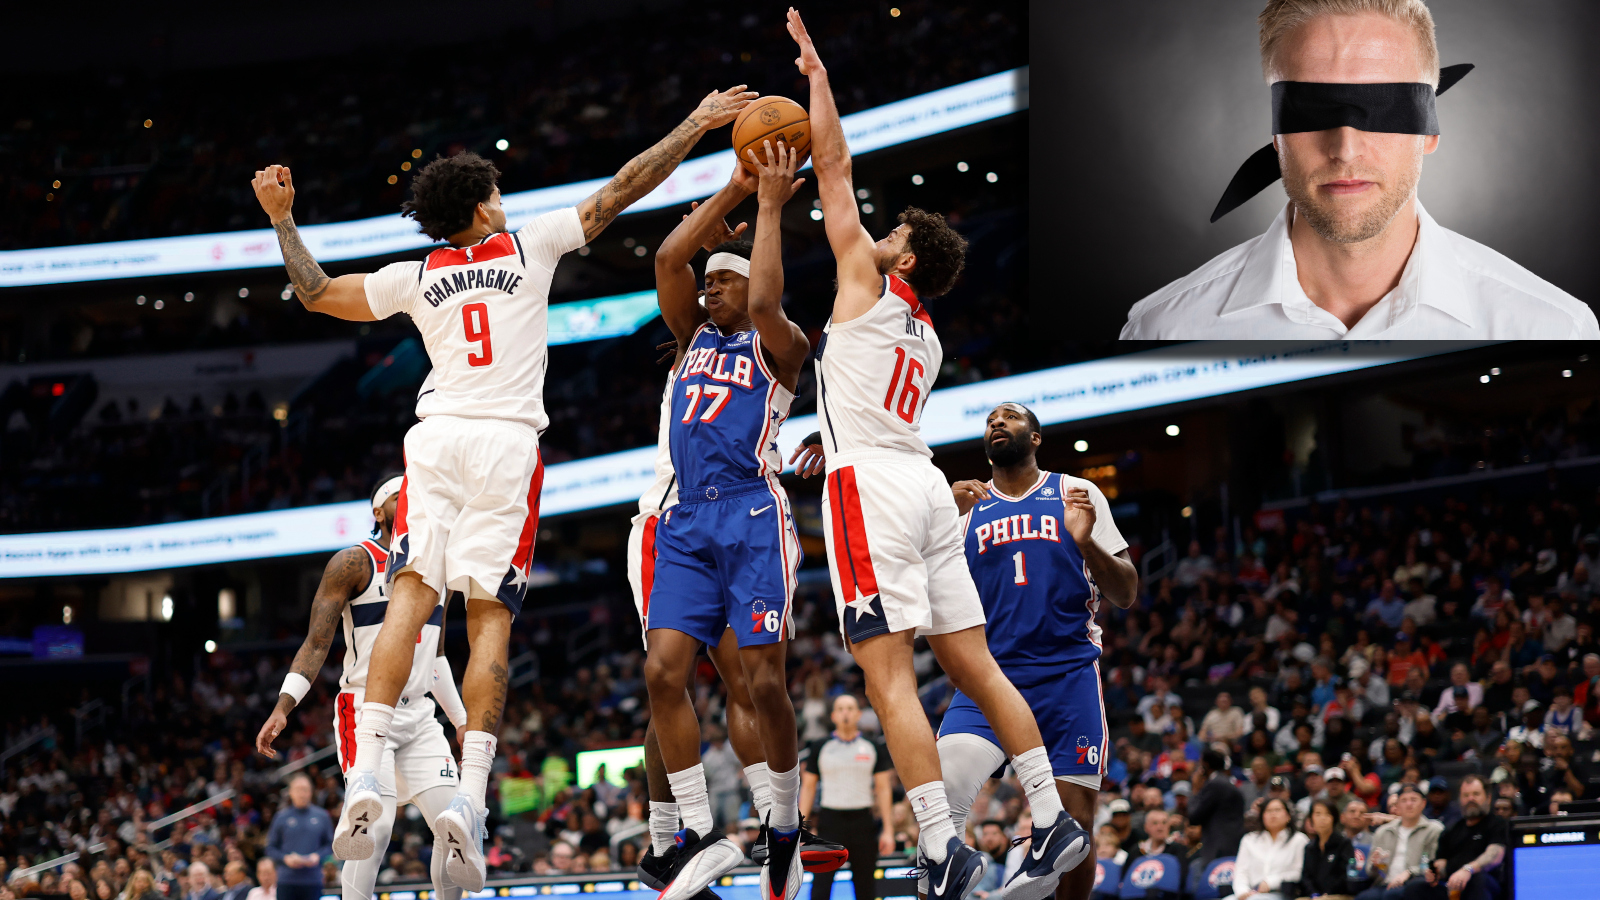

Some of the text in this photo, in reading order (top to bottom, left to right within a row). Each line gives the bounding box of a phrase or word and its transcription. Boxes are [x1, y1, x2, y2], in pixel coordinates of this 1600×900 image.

[424, 268, 523, 308] CHAMPAGNIE
[461, 302, 493, 367] 9
[680, 347, 755, 390] PHILA
[883, 346, 924, 424] 16
[681, 383, 733, 424] 77
[975, 513, 1062, 555] PHILA
[1012, 551, 1028, 586] 1
[751, 610, 780, 633] 76
[1075, 745, 1099, 766] 76
